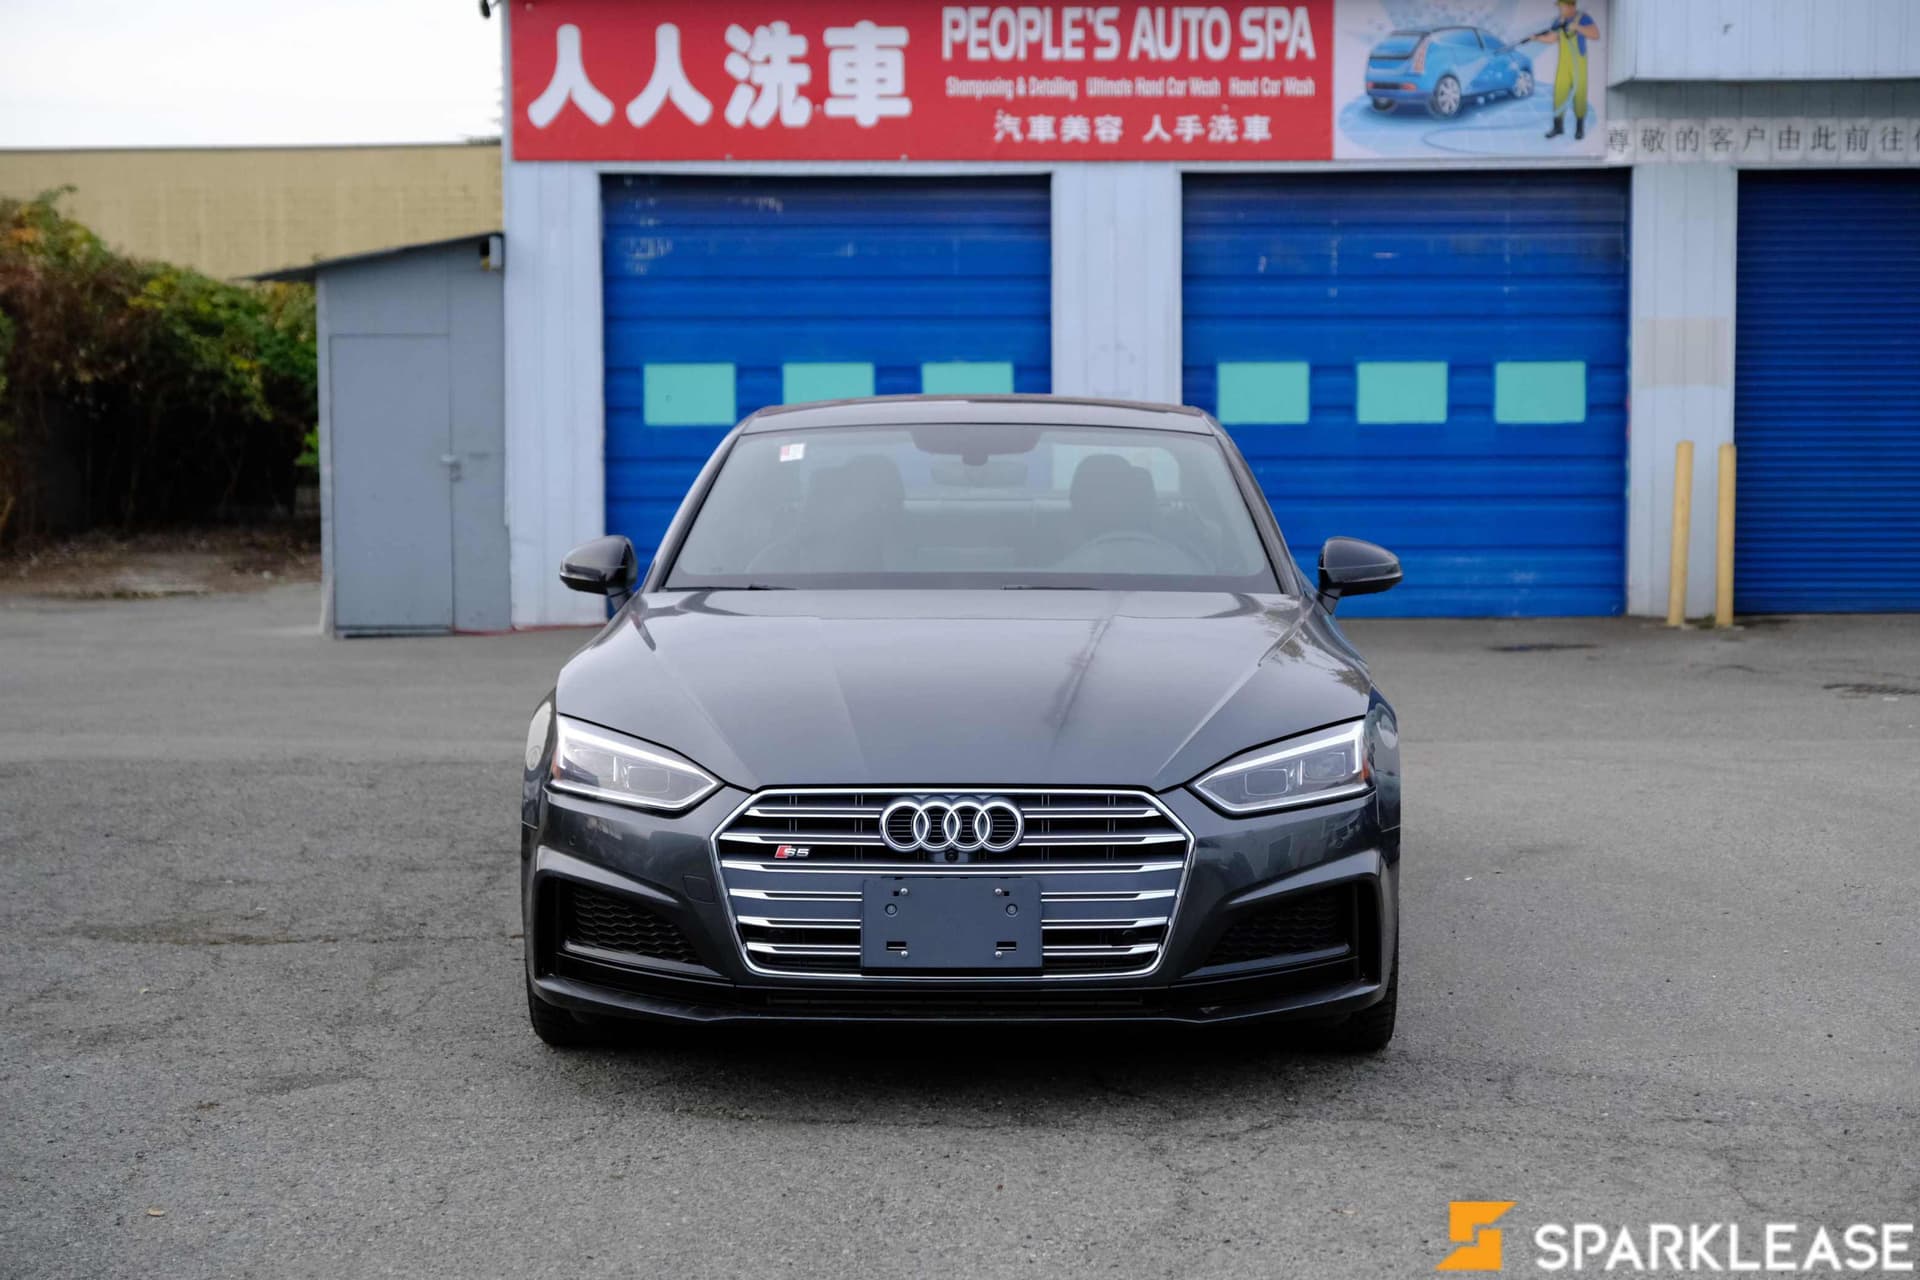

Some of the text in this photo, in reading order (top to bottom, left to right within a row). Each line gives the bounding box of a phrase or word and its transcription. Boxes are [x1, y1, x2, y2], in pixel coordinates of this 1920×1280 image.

[942, 7, 1316, 61] PEOPLE'S AUTO SPA
[528, 20, 912, 128] 人人洗車
[1016, 76, 1026, 97] &
[1029, 76, 1078, 100] Detailing
[1086, 77, 1132, 97] Ultimate
[1135, 77, 1165, 97] Hand
[1167, 77, 1187, 97] Car
[1189, 77, 1221, 97] Wash
[1229, 77, 1258, 97] Hand
[1260, 77, 1281, 97] Car
[1283, 77, 1315, 97] Wash
[994, 111, 1272, 143] 汽車美容 人手洗車
[779, 846, 809, 858] S5
